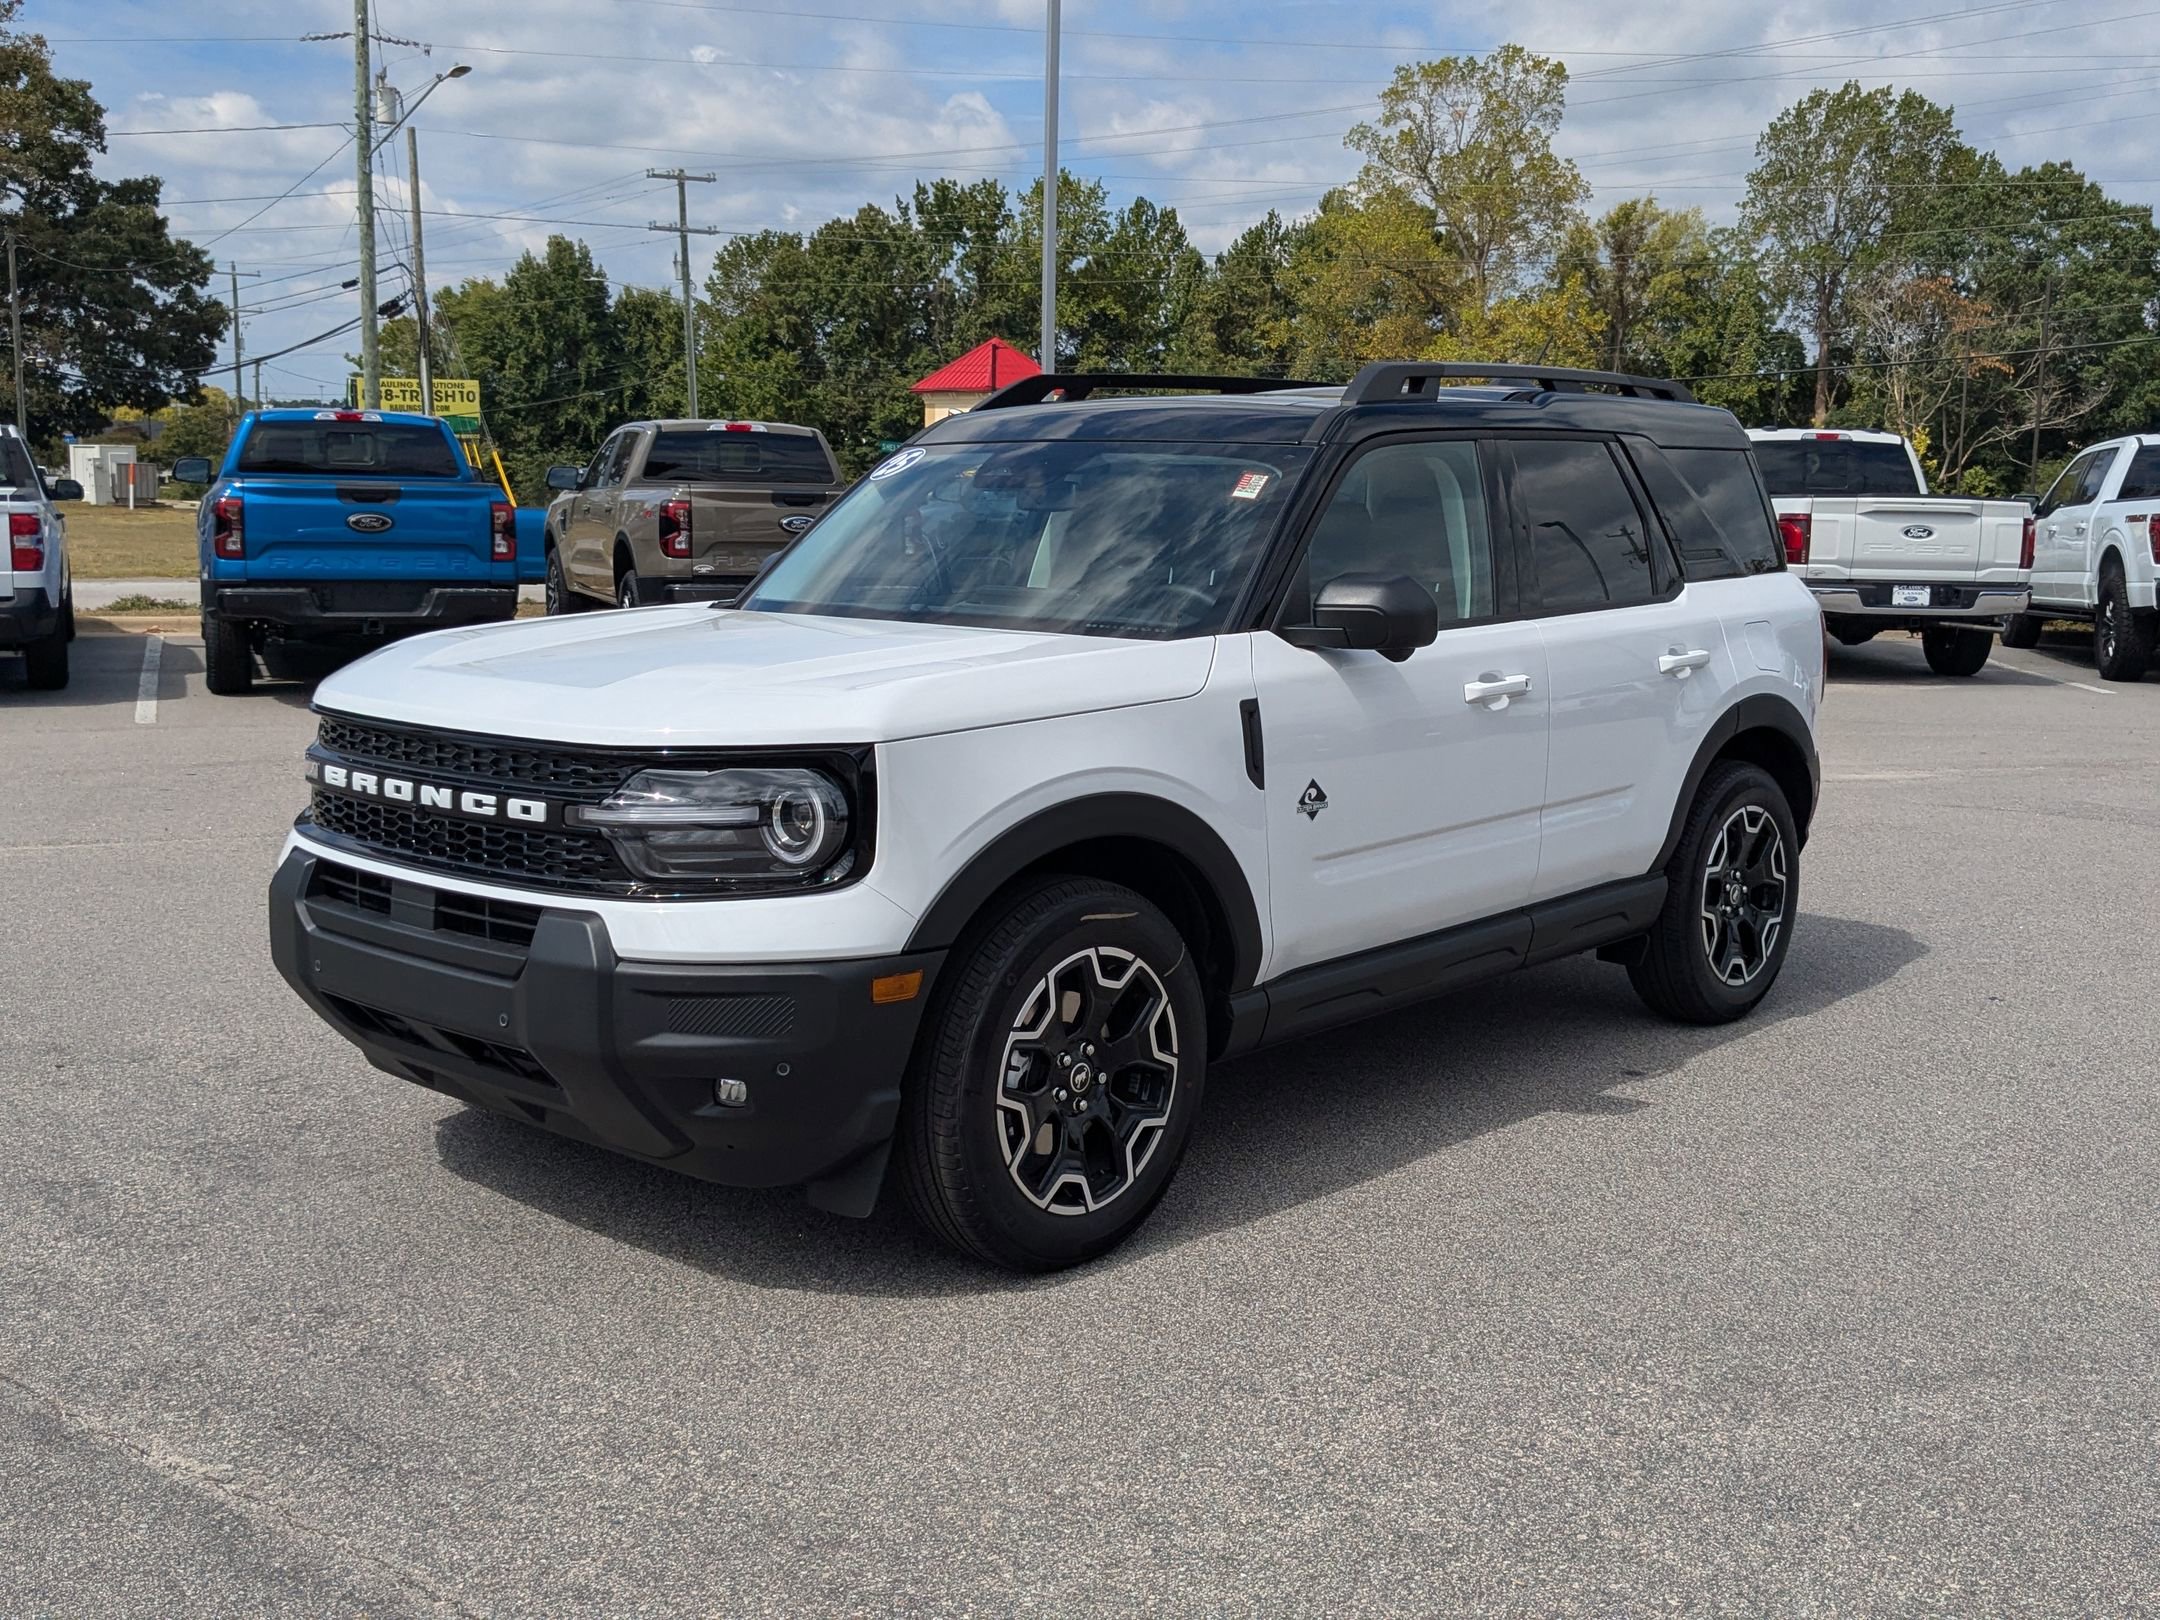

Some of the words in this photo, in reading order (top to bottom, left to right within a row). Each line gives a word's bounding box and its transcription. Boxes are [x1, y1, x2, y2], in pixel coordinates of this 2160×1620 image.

[362, 389, 476, 402] 8-TRSH10
[1907, 526, 1929, 537] Ford
[269, 556, 470, 570] RANGER
[324, 764, 547, 823] BRONCO
